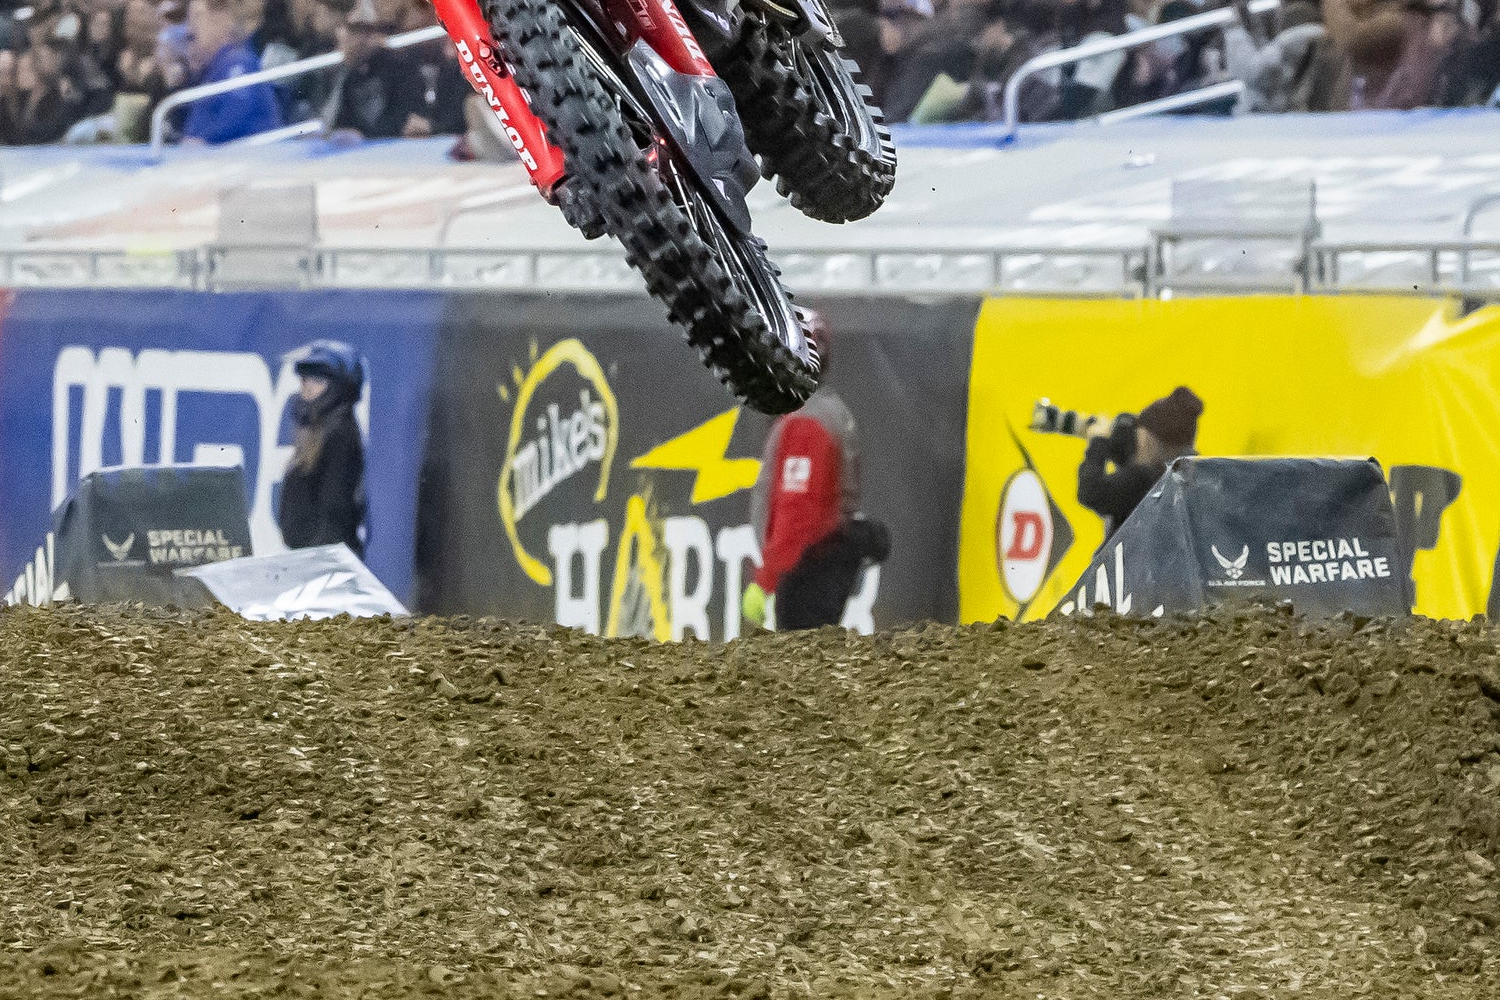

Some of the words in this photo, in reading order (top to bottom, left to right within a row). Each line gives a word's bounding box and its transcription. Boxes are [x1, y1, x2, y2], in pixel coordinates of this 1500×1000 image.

[456, 39, 539, 172] DUNLOP
[147, 528, 231, 547] SPECIAL
[1267, 536, 1370, 564] SPECIAL
[1269, 556, 1392, 587] WARFARE
